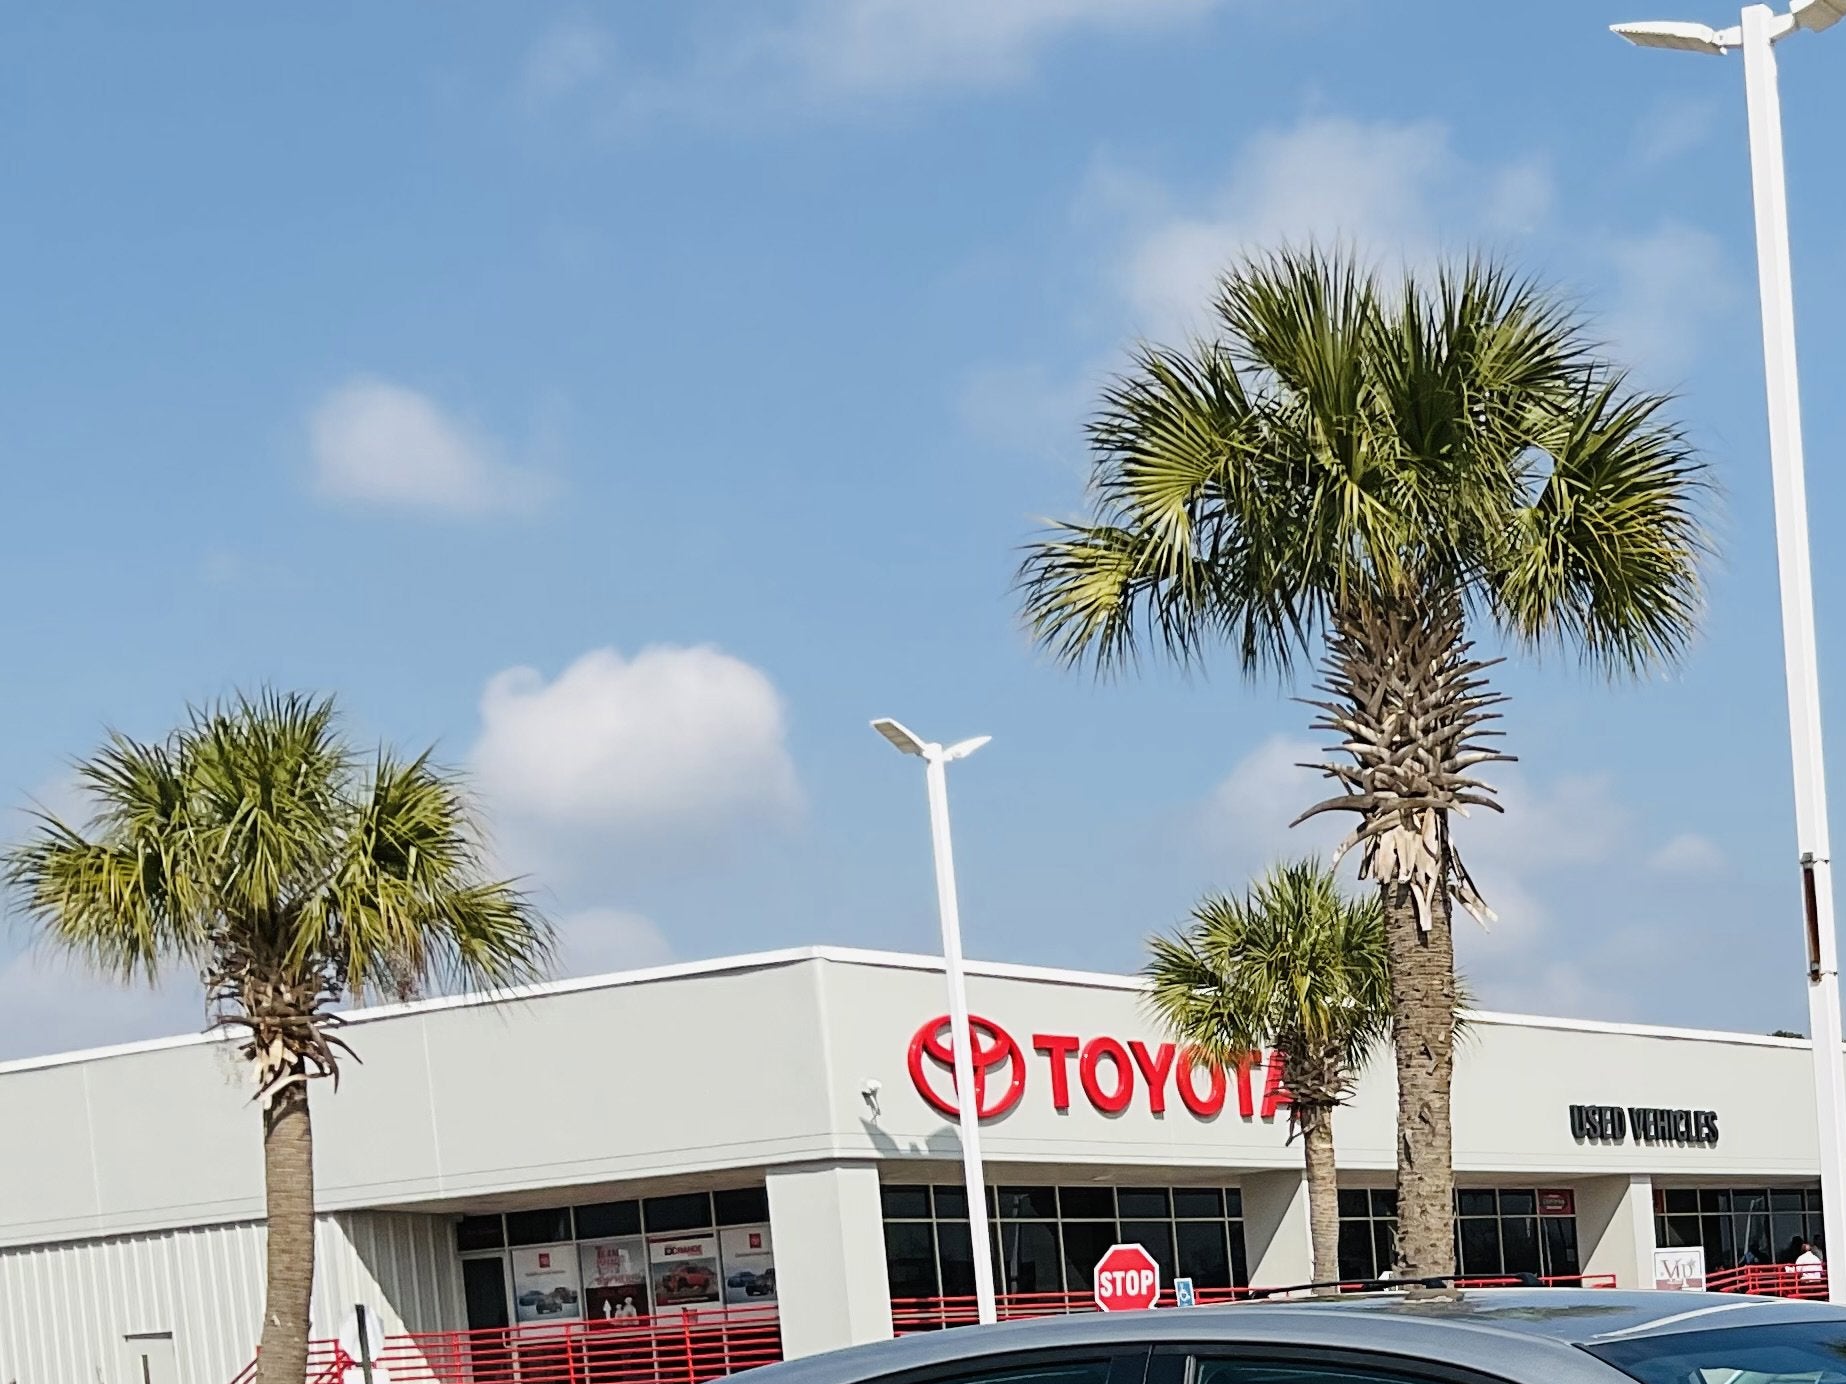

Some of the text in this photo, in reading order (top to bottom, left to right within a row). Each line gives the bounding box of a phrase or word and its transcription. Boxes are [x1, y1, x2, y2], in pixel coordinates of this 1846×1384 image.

[1569, 1105, 1719, 1144] USED VEHICLES
[1100, 1269, 1154, 1298] STOP
